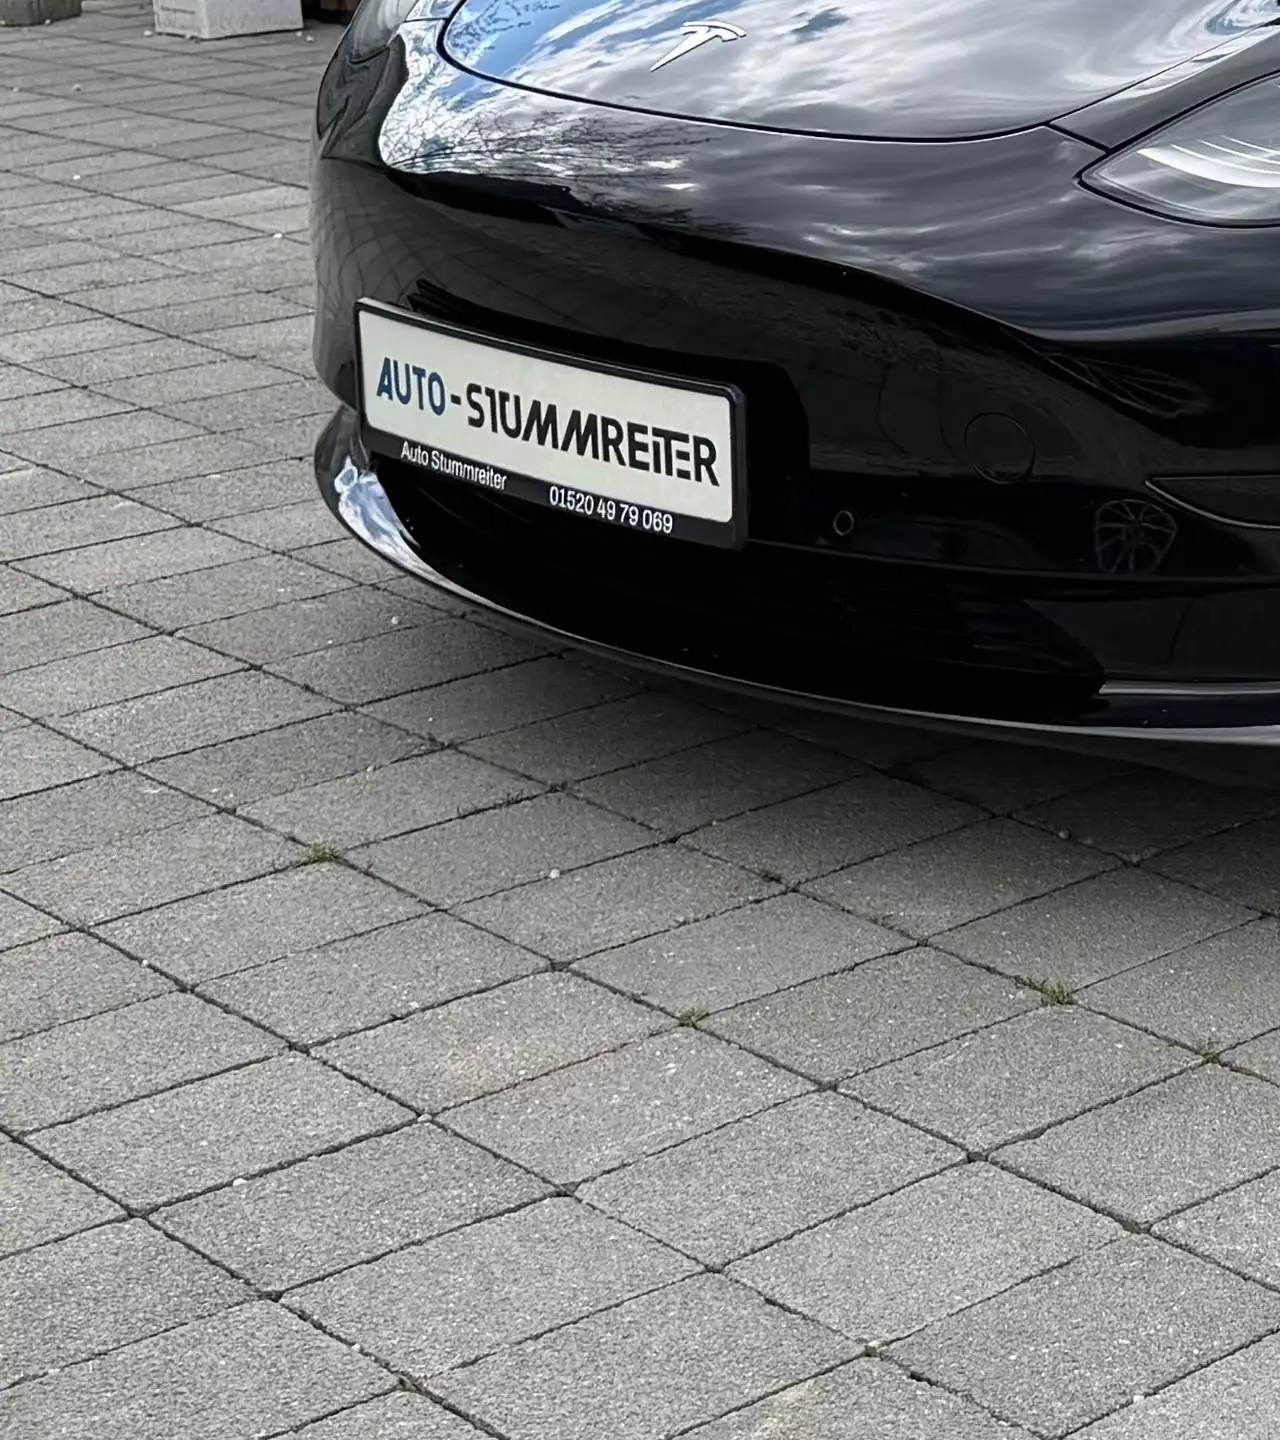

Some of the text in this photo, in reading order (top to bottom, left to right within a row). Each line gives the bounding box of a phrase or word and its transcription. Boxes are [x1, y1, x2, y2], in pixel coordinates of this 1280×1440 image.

[401, 440, 507, 491] Auto Stummreiter
[549, 485, 674, 534] 01520 49 79 069
